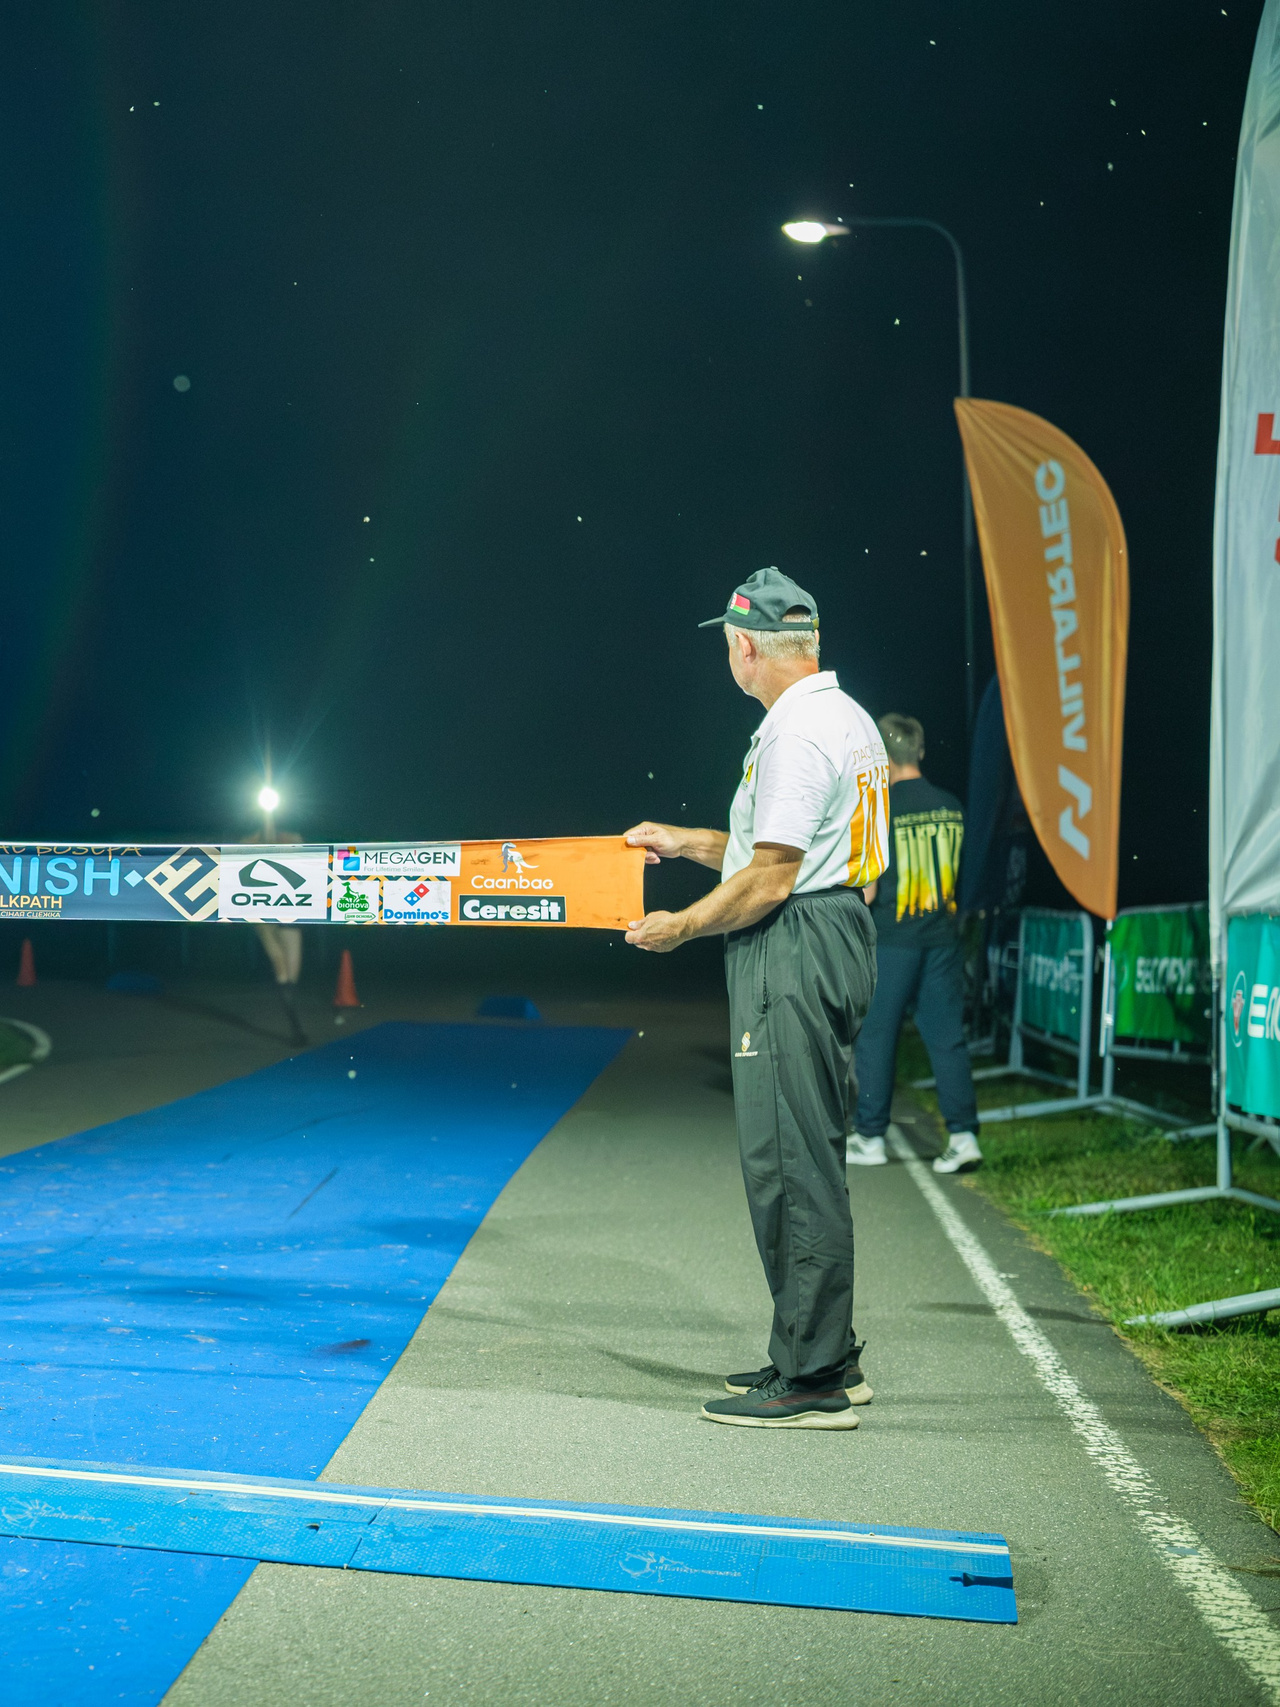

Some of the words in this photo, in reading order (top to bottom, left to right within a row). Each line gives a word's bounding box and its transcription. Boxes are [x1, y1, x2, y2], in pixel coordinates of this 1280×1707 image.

[231, 893, 312, 906] ORAZ
[384, 909, 449, 920] Domino's
[463, 899, 560, 920] Ceresit
